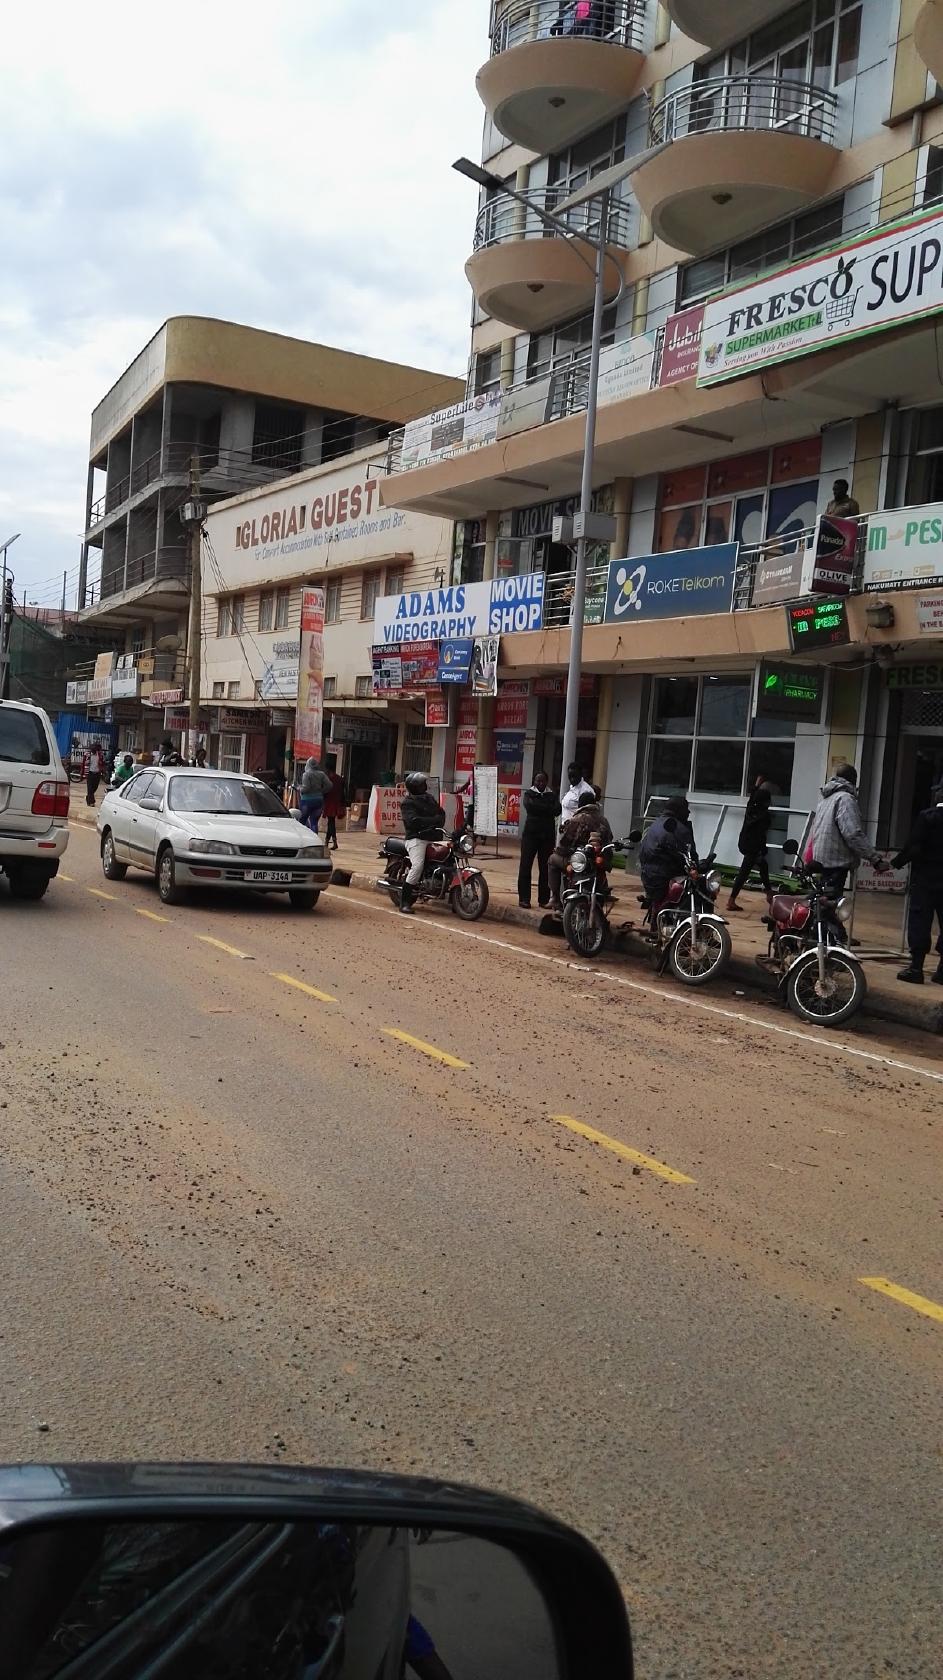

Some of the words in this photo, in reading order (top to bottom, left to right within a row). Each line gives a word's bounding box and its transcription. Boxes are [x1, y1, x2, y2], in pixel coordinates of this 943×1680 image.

[866, 238, 943, 311] SUP
[726, 267, 854, 337] FRESCO
[668, 319, 701, 351] Jubil
[725, 315, 813, 353] SUPERMARKET
[666, 364, 690, 378] AGENCY
[241, 505, 298, 550] GLORIA
[311, 480, 378, 530] GUEST
[820, 534, 844, 545] Panadol
[904, 518, 943, 546] PES
[491, 575, 544, 602] MOVIE
[819, 570, 848, 581] OLIVE
[902, 577, 937, 588] ENTRANCE
[396, 586, 466, 620] ADAMS
[383, 616, 477, 642] VIDEOGRAPHY
[490, 604, 541, 634] SHOP
[886, 665, 943, 686] FRES
[785, 689, 817, 700] PHARMACY
[381, 812, 402, 821] BURE
[386, 800, 401, 809] FOR
[253, 871, 269, 880] UAP
